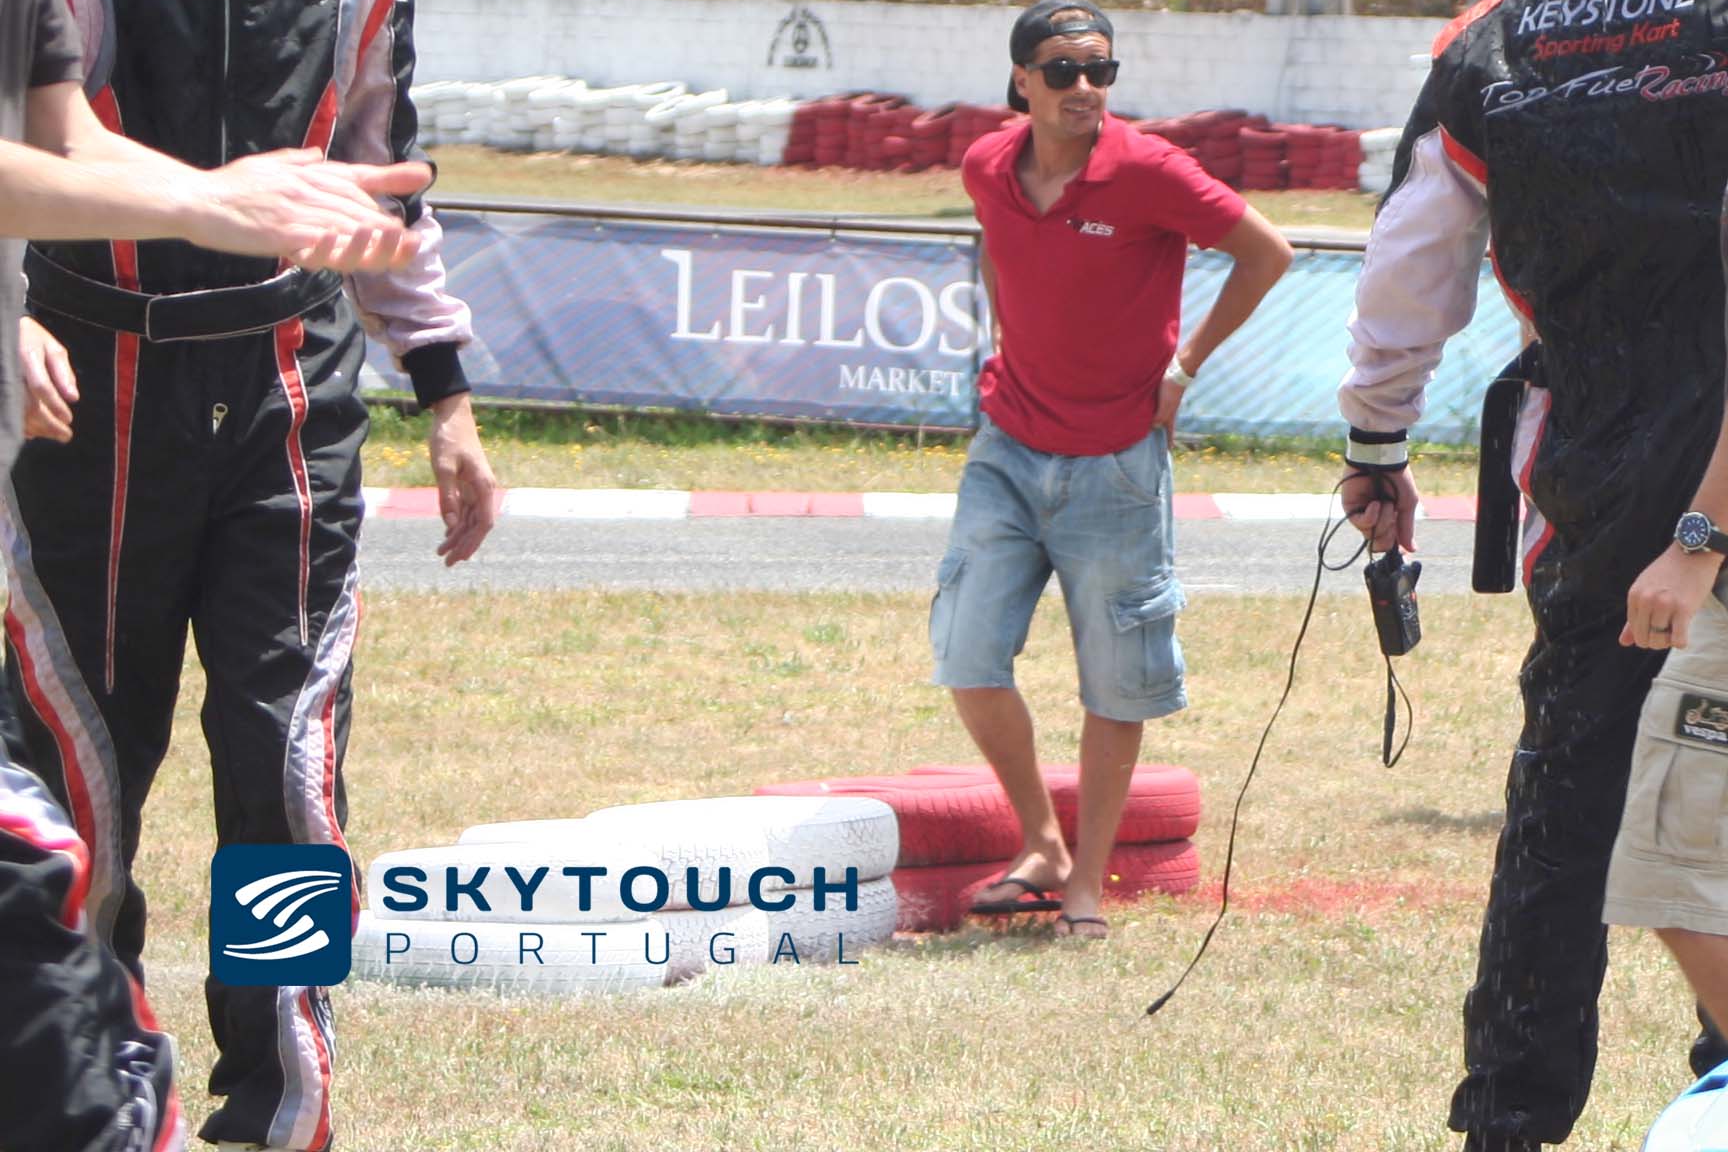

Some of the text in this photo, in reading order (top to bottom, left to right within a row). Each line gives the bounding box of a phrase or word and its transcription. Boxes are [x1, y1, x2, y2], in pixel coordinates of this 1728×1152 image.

[1533, 17, 1682, 61] Sporting Kart
[1480, 80, 1548, 116] Top
[839, 364, 965, 396] MARKET
